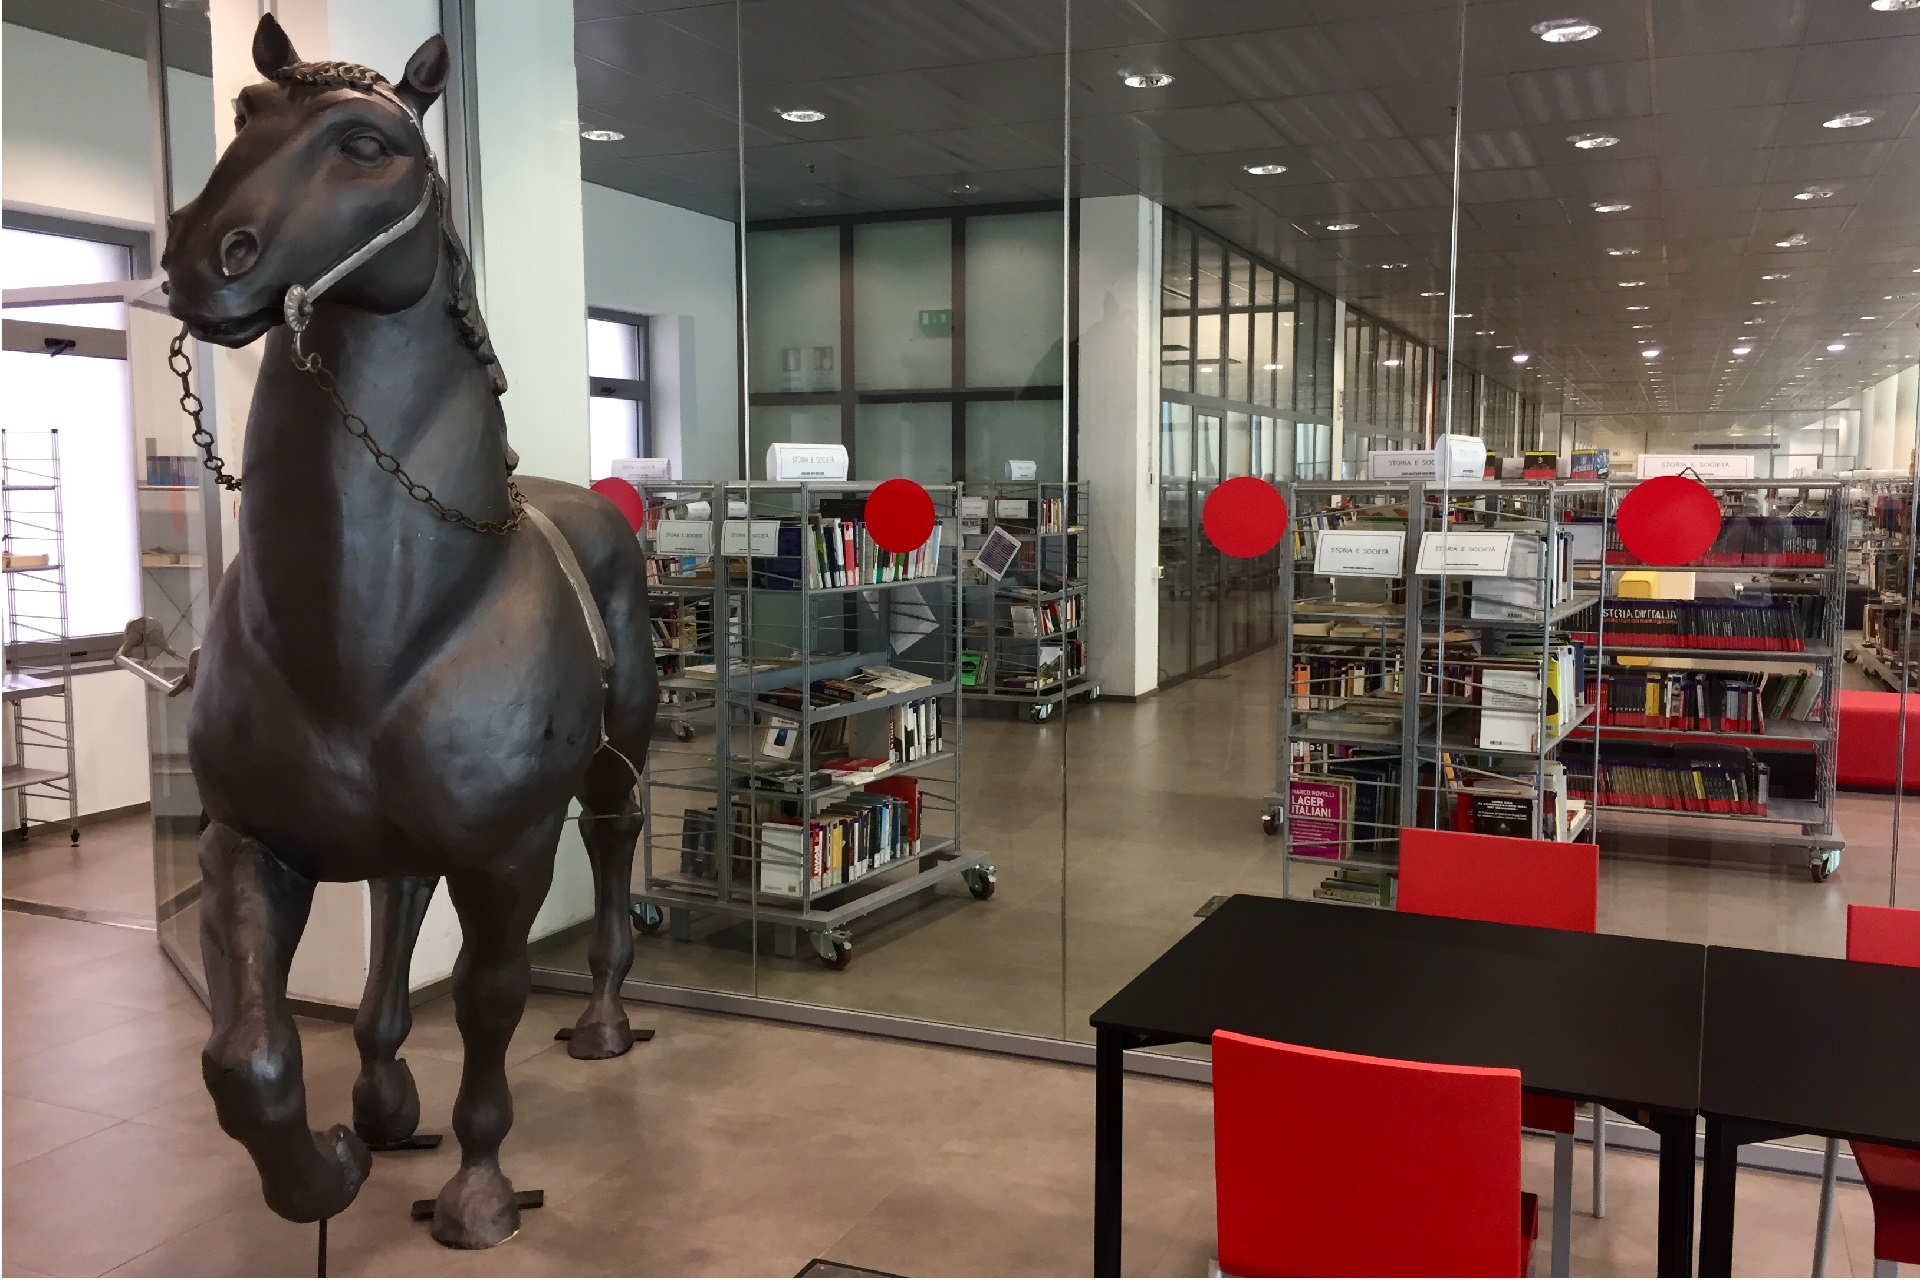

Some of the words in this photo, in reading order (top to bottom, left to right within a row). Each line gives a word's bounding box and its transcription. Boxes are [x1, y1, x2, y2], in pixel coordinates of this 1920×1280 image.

[1388, 459, 1412, 467] STORIA
[1291, 788, 1311, 796] MARCO
[1311, 790, 1335, 798] ROVELLI
[1291, 795, 1324, 807] LAGER
[1291, 804, 1331, 818] ITALIANI
